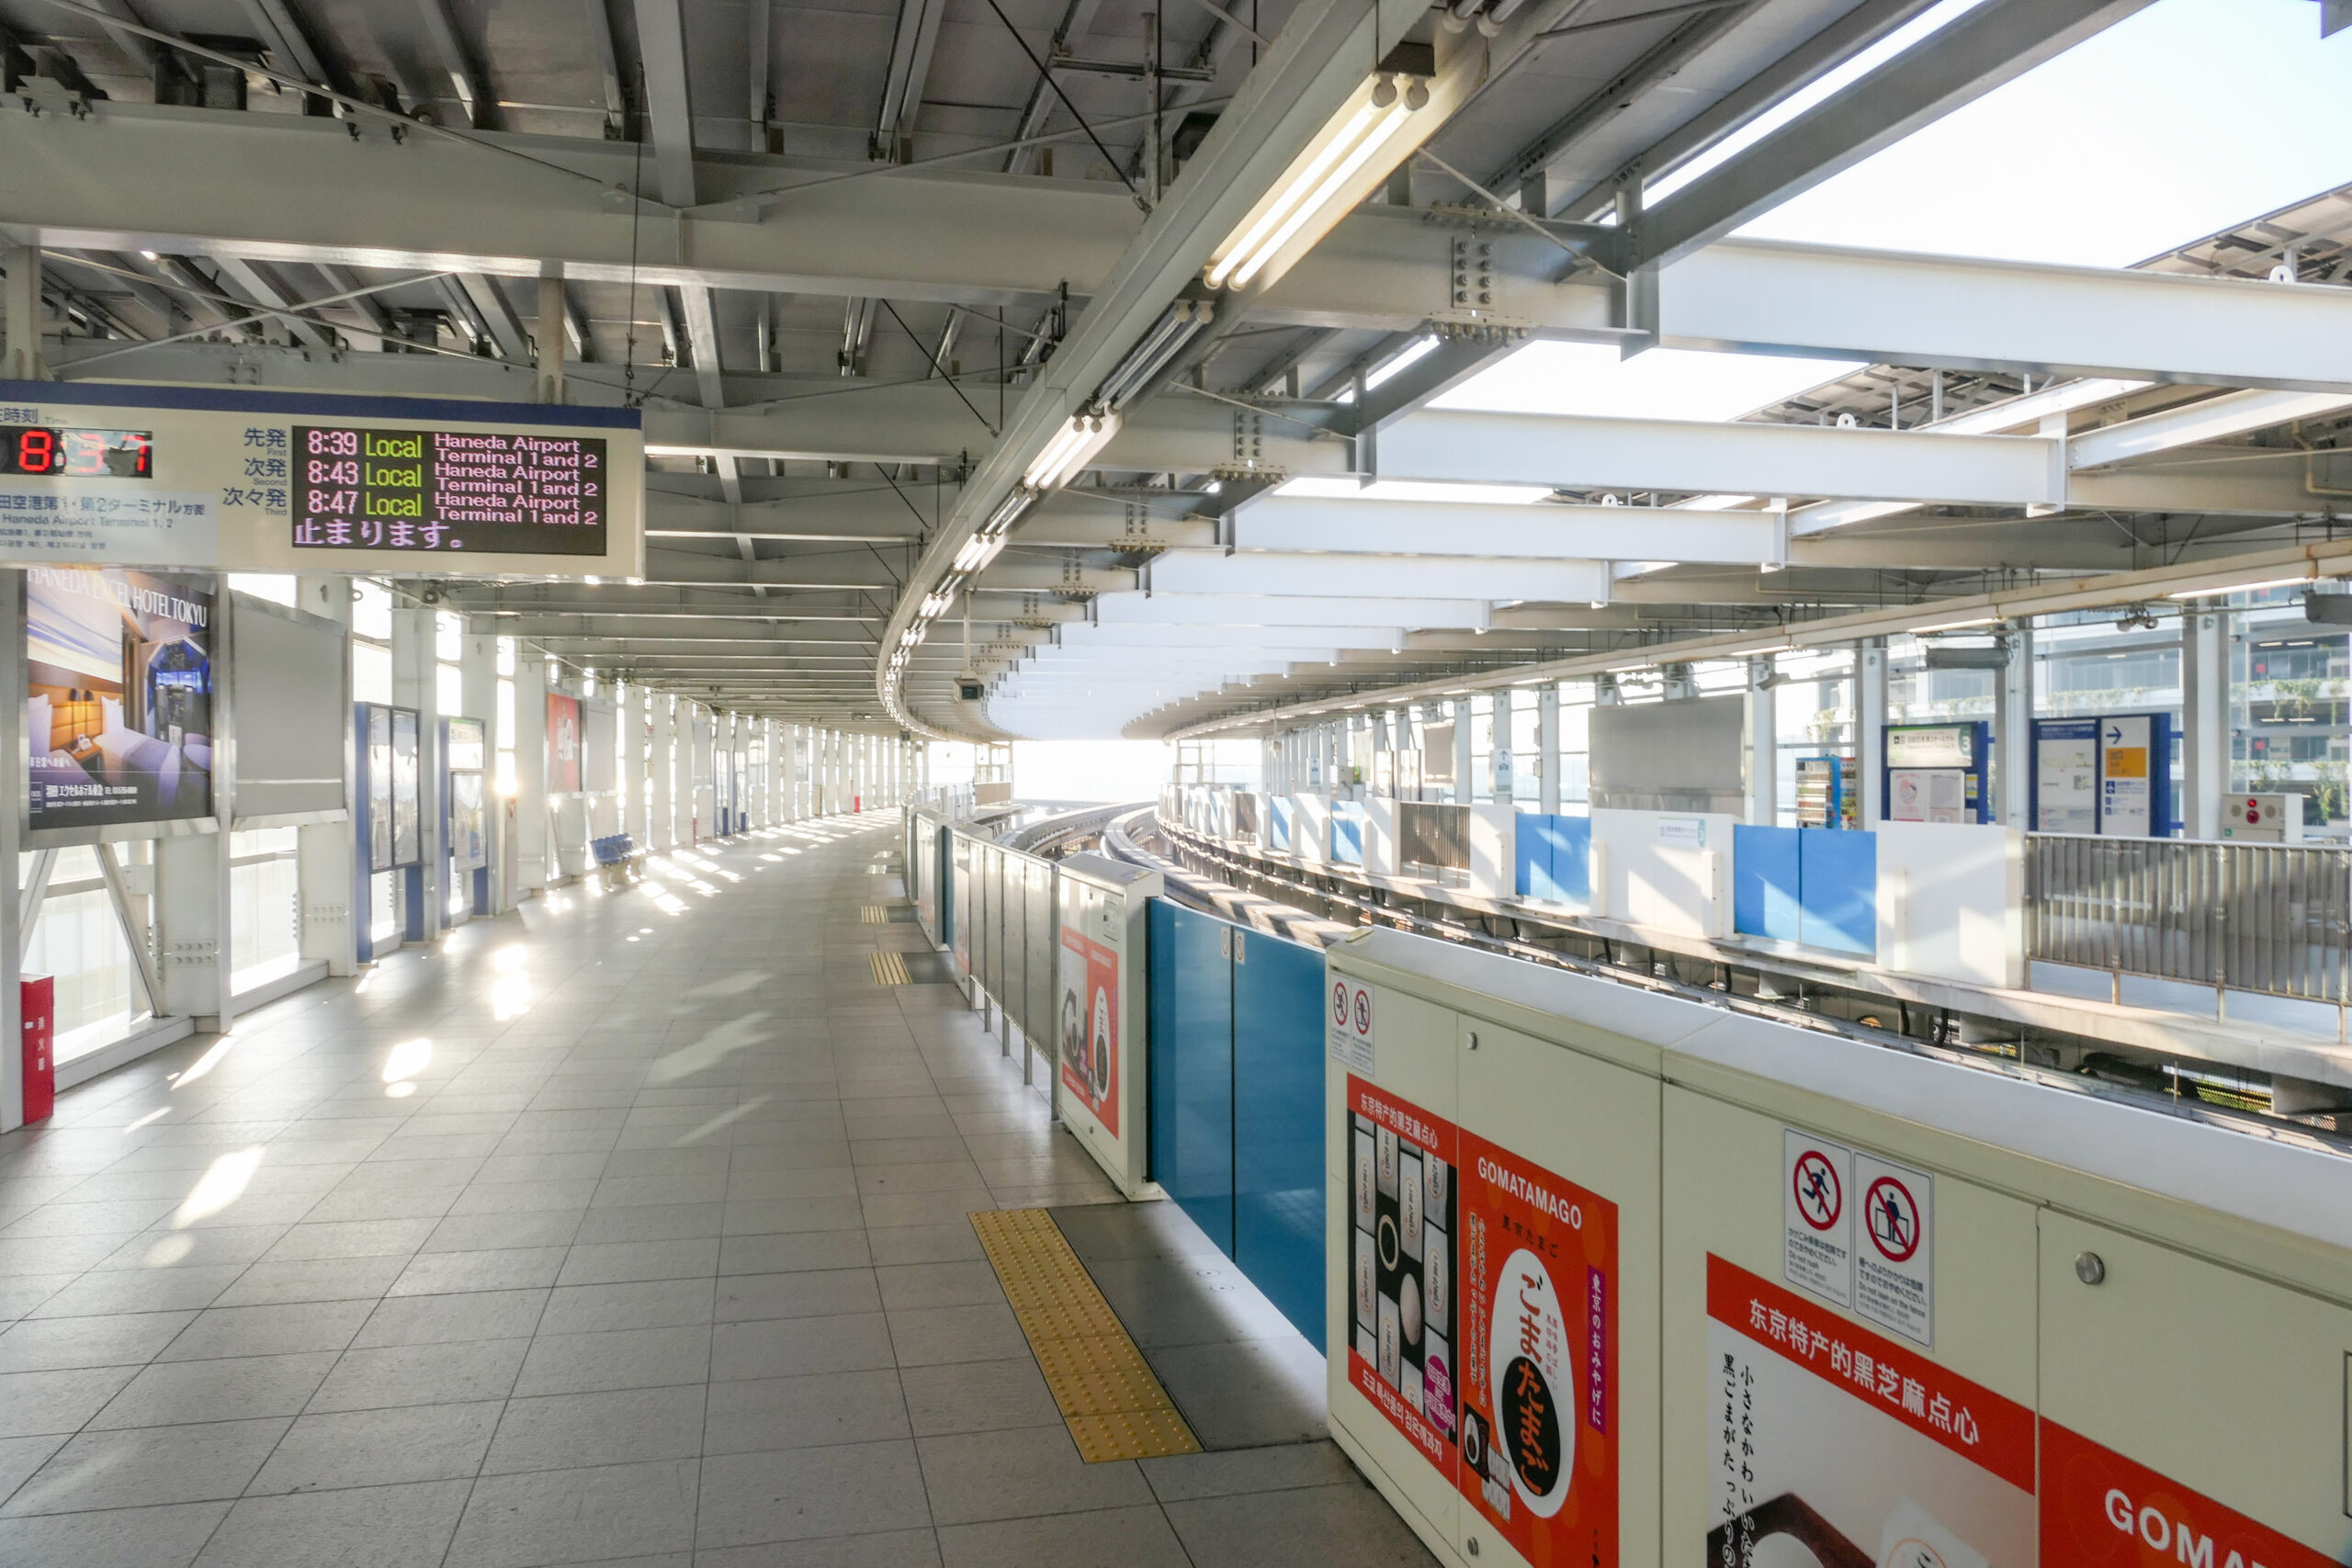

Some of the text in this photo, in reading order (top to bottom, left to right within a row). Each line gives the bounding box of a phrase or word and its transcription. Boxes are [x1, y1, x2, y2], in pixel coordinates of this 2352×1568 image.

[45, 417, 68, 425] Time
[243, 427, 287, 448] 先発
[308, 430, 422, 458] 8:39 Local
[435, 433, 580, 454] Haneda Airport
[266, 448, 287, 457] First
[435, 447, 523, 466] Terminal
[542, 454, 580, 467] and
[584, 455, 597, 468] 2
[243, 457, 287, 478] 次発
[308, 459, 422, 488] 8:43 Local
[435, 462, 580, 482] Haneda Airport
[254, 478, 287, 487] Second
[435, 477, 523, 493] Terminal
[542, 482, 580, 496] and
[584, 482, 597, 497] 2
[222, 487, 287, 507] 次々発
[308, 490, 422, 517] 8:47 Local
[435, 491, 580, 512] Haneda Airport
[2, 513, 50, 525] Haneda
[53, 516, 95, 528] Airport
[100, 516, 150, 527] Terminal
[166, 518, 174, 528] 2
[265, 507, 287, 516] Third
[435, 506, 523, 523] Terminal
[542, 511, 580, 525] and
[584, 512, 597, 525] 2
[294, 518, 463, 549] 止まります。
[28, 568, 208, 627] HANEDA EXCEL HOTEL TOKYU
[1361, 1092, 1439, 1150] 东京特产的黑芝麻点心
[1478, 1156, 1582, 1230] GOMATAMAGO
[1591, 1273, 1602, 1426] 東京のおみやげに
[1748, 1298, 1980, 1446] 东京特产的黑芝麻点心
[1723, 1353, 1736, 1568] 黒ごまがたっぷりの
[2105, 1488, 2267, 1568] GOM
